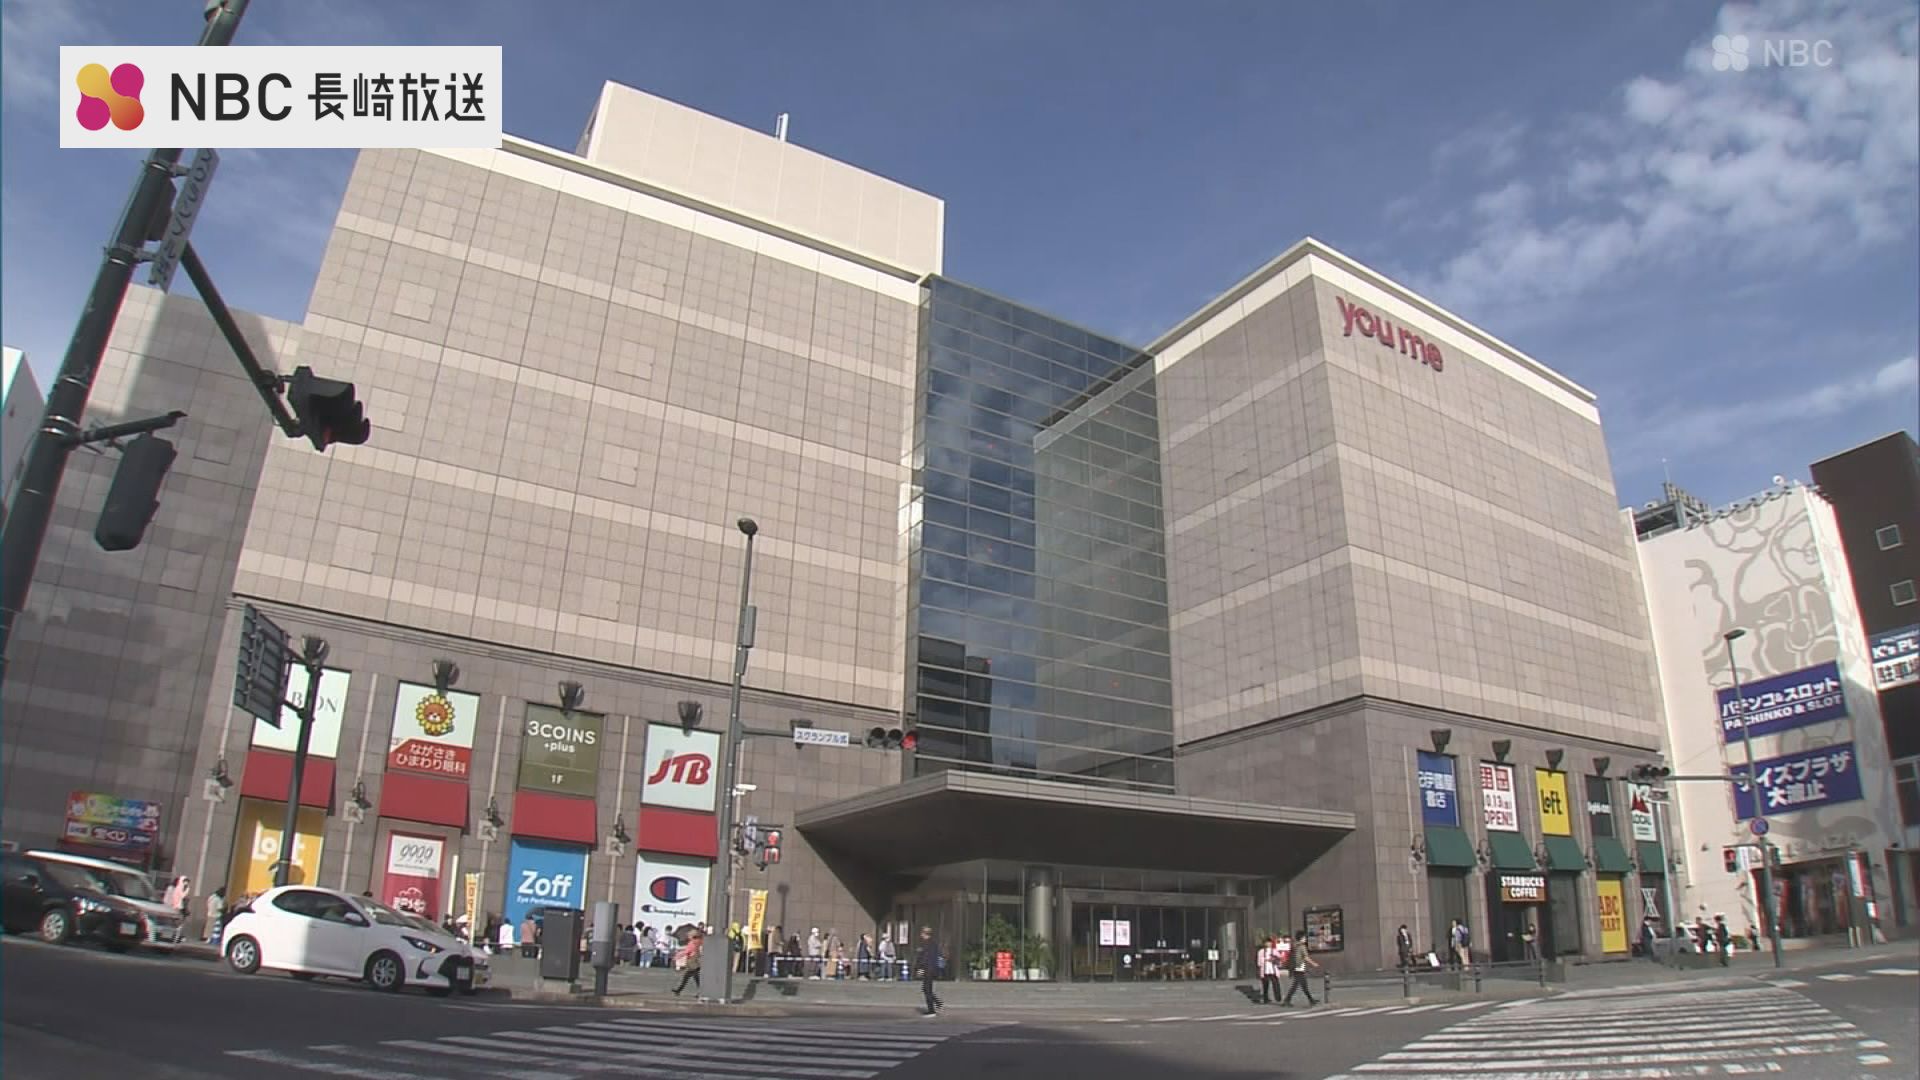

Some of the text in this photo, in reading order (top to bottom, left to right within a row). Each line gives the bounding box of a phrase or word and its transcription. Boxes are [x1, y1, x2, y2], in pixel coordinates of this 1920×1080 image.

[1724, 706, 1794, 730] PACHINKO
[1806, 694, 1842, 712] SLOT
[527, 720, 597, 745] 3COINS
[410, 743, 457, 760] ながさき
[396, 753, 467, 774] ひまわり眼科
[647, 752, 712, 786] JTB
[551, 774, 564, 784] 1F
[1540, 789, 1563, 815] Loft
[251, 820, 305, 867] Lot
[518, 869, 573, 898] Zoff
[1500, 875, 1545, 888] STARBUCKS
[1510, 887, 1538, 898] COFFEE
[1598, 895, 1619, 916] ABC
